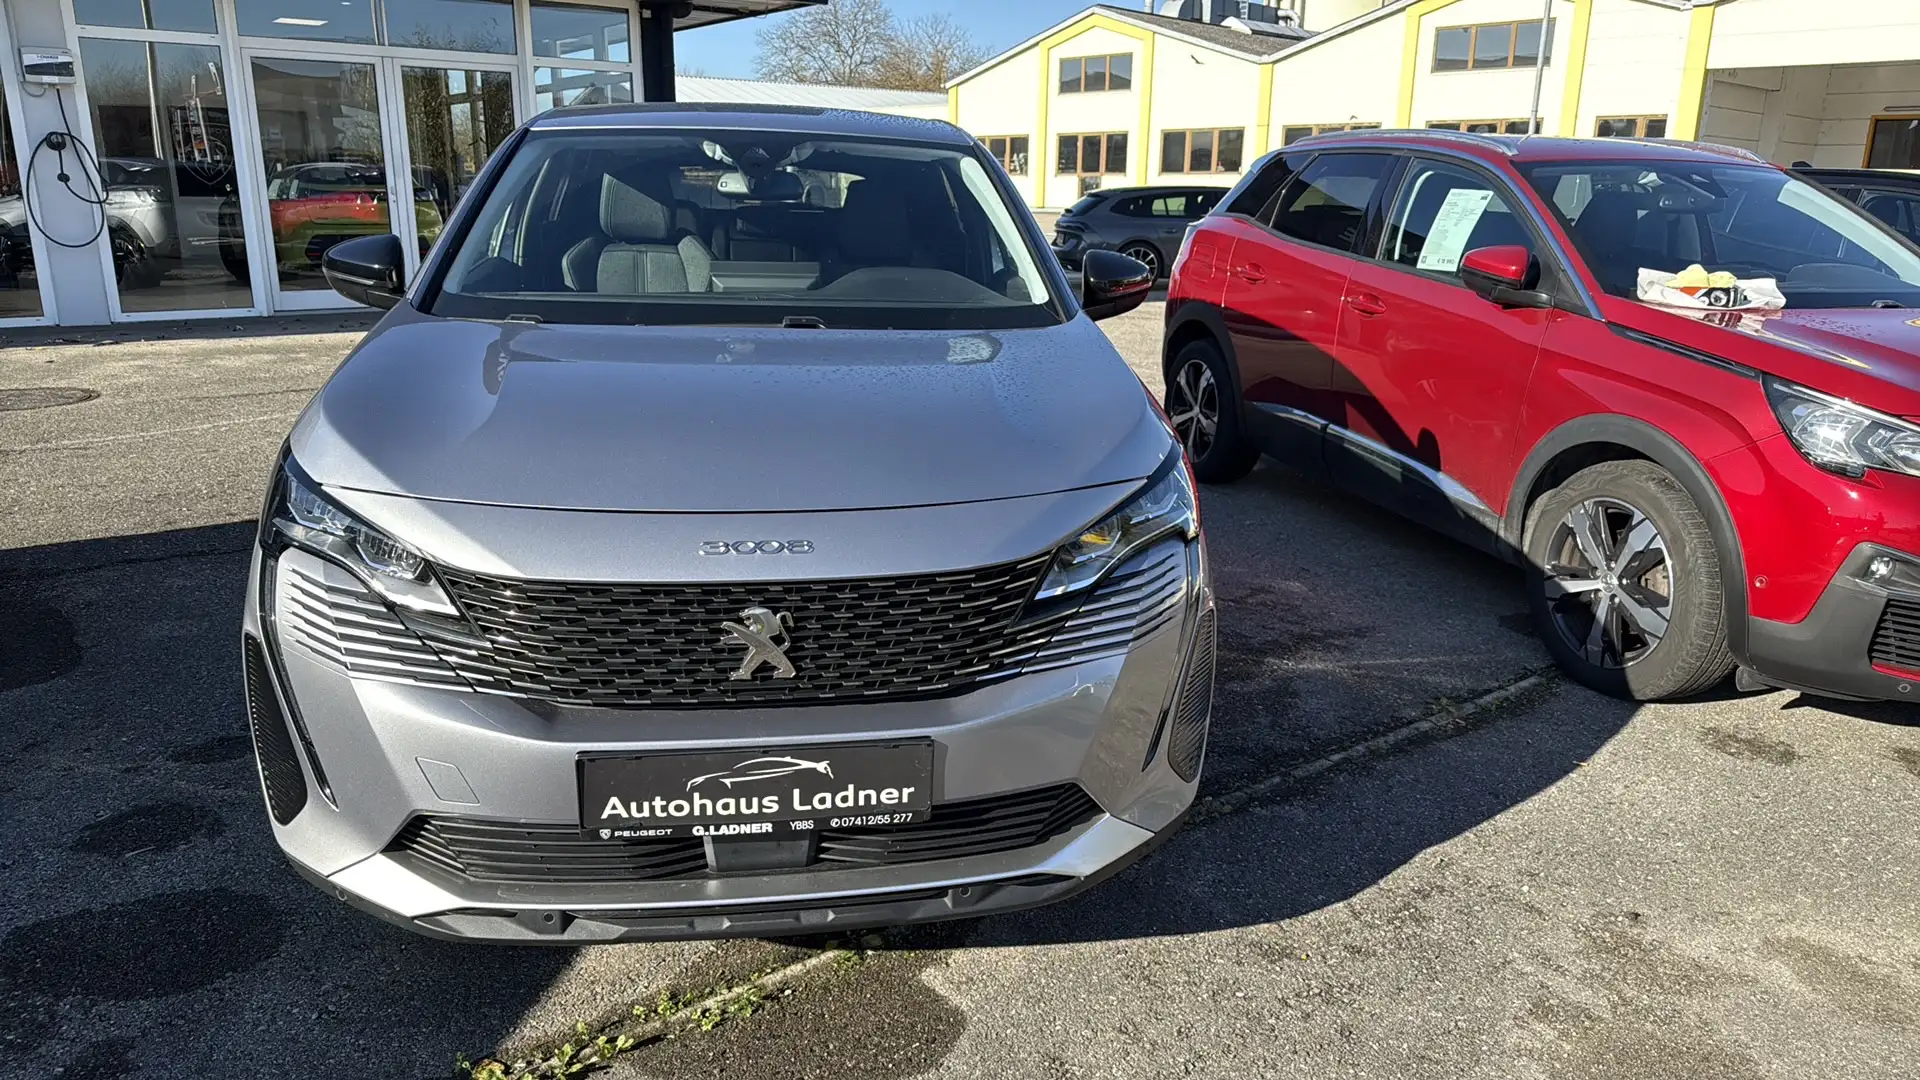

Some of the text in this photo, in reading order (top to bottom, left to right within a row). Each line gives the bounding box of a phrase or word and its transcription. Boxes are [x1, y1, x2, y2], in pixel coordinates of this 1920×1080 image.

[698, 540, 815, 555] 3008
[600, 784, 915, 820] Autohaus Ladner
[614, 812, 913, 838] PEUGEOT G.LADNER YBBS 07412/55 277
